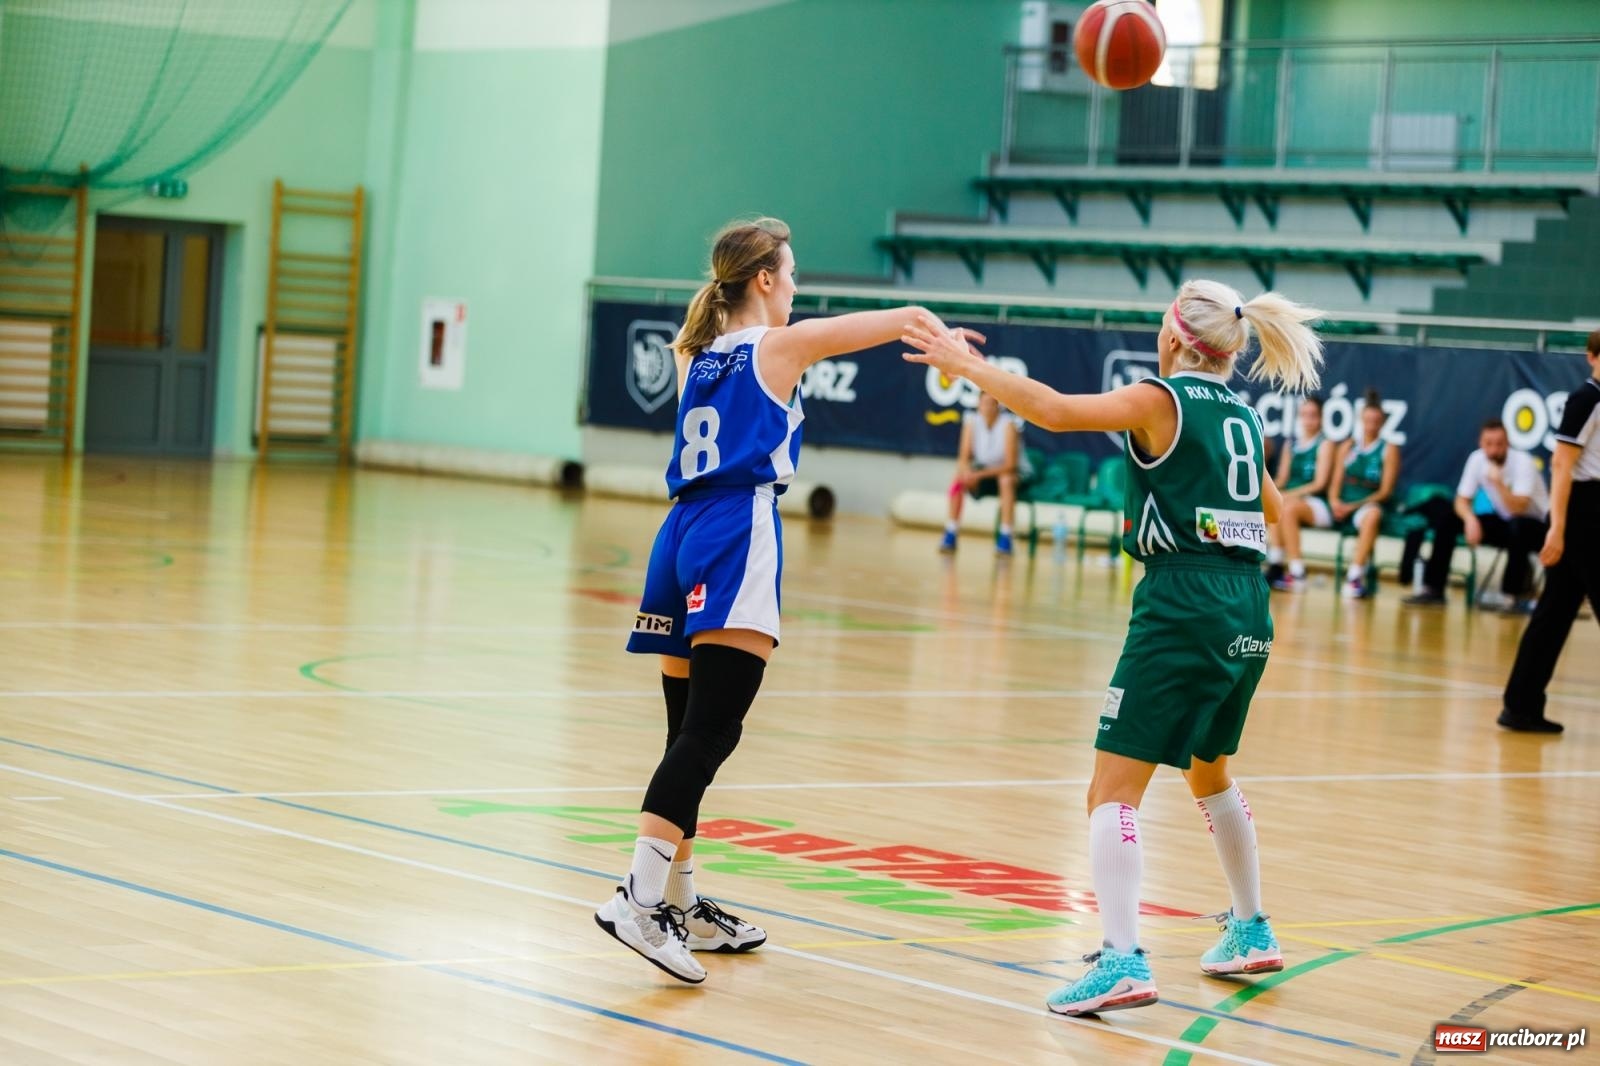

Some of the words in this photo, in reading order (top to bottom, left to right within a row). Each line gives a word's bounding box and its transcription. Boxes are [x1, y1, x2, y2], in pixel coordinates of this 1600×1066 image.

[680, 405, 720, 480] 8
[1223, 417, 1260, 502] 8
[635, 615, 672, 632] TIM
[1241, 635, 1272, 653] Clavis
[1119, 803, 1137, 844] ALLSIX
